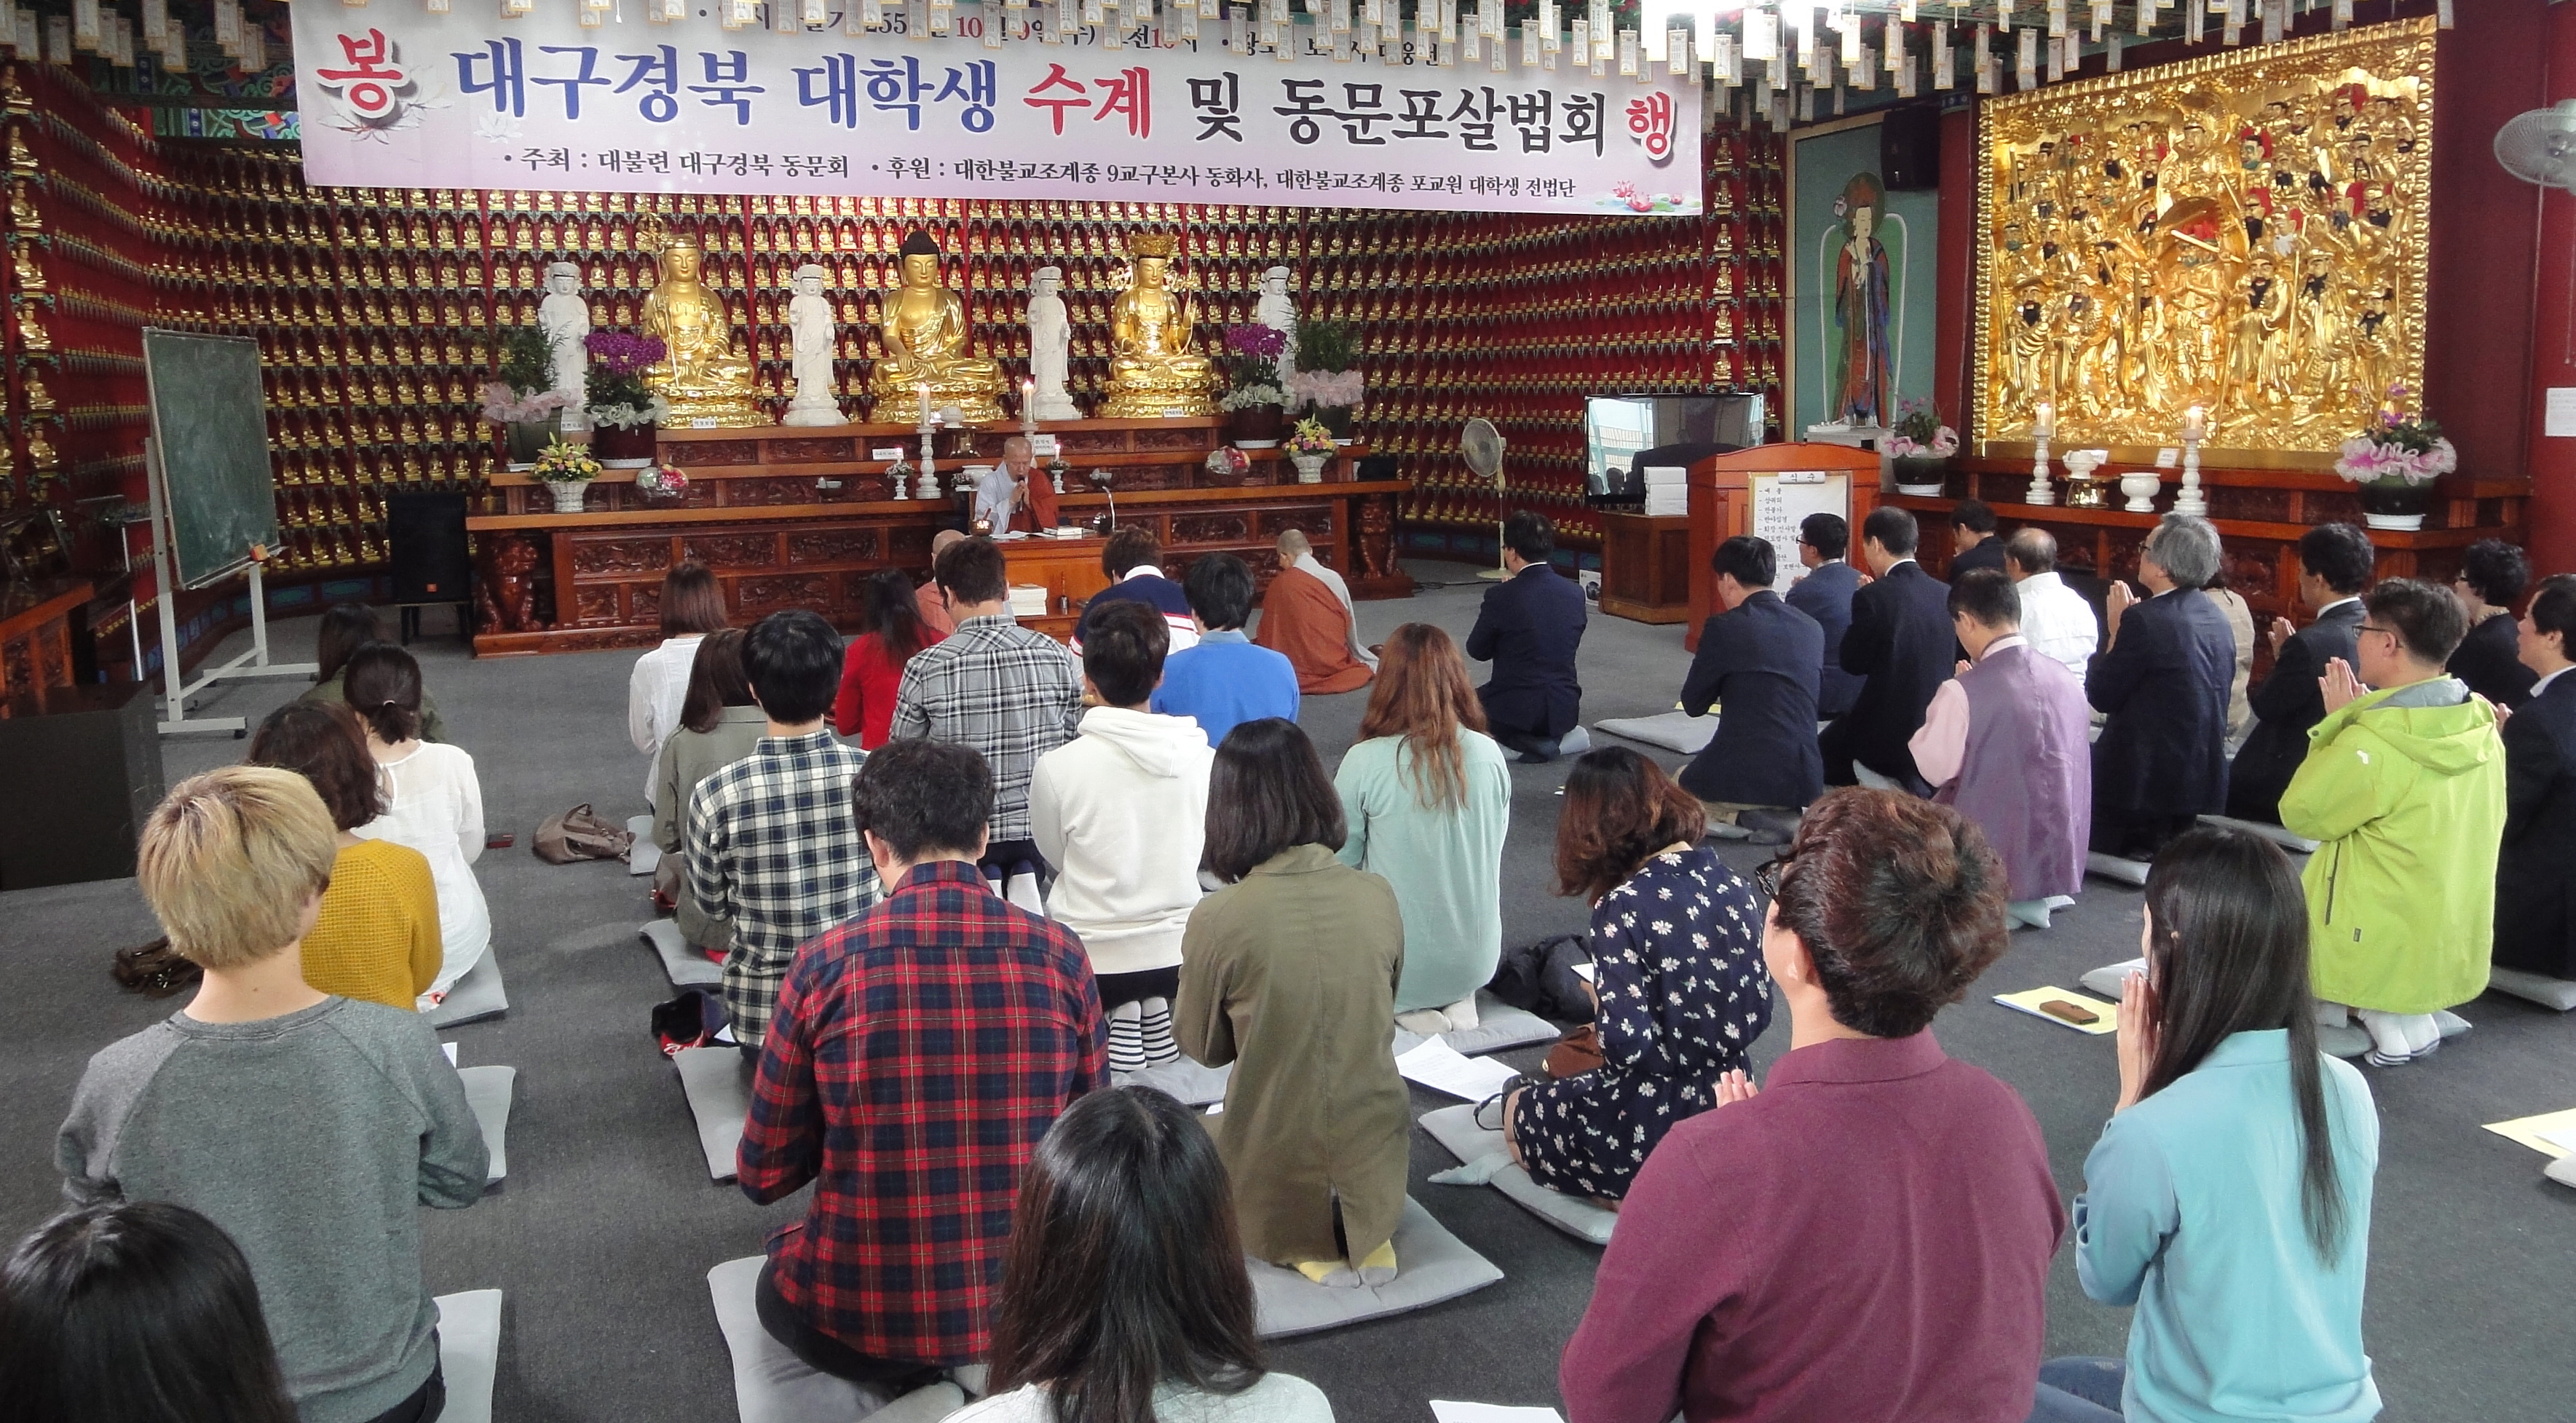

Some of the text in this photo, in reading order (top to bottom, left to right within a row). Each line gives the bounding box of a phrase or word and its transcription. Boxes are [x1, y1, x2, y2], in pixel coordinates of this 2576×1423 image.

[316, 28, 403, 111] 봉
[449, 36, 1605, 157] 대구경북 대학생 수계 및 동문포살법회
[1625, 91, 1671, 154] 행
[521, 148, 570, 172] 주최
[598, 149, 671, 175] 대불련
[679, 151, 773, 177] 대구경북
[779, 154, 848, 178] 동문회
[886, 156, 931, 180] 후원
[955, 159, 1101, 184] 대한불교조계종
[1107, 165, 1200, 187] 9교구본사
[1276, 170, 1404, 194] 대한불교조계종
[1410, 173, 1463, 195] 포교원
[1469, 175, 1519, 197] 대학생
[1526, 177, 1576, 199] 전법단
